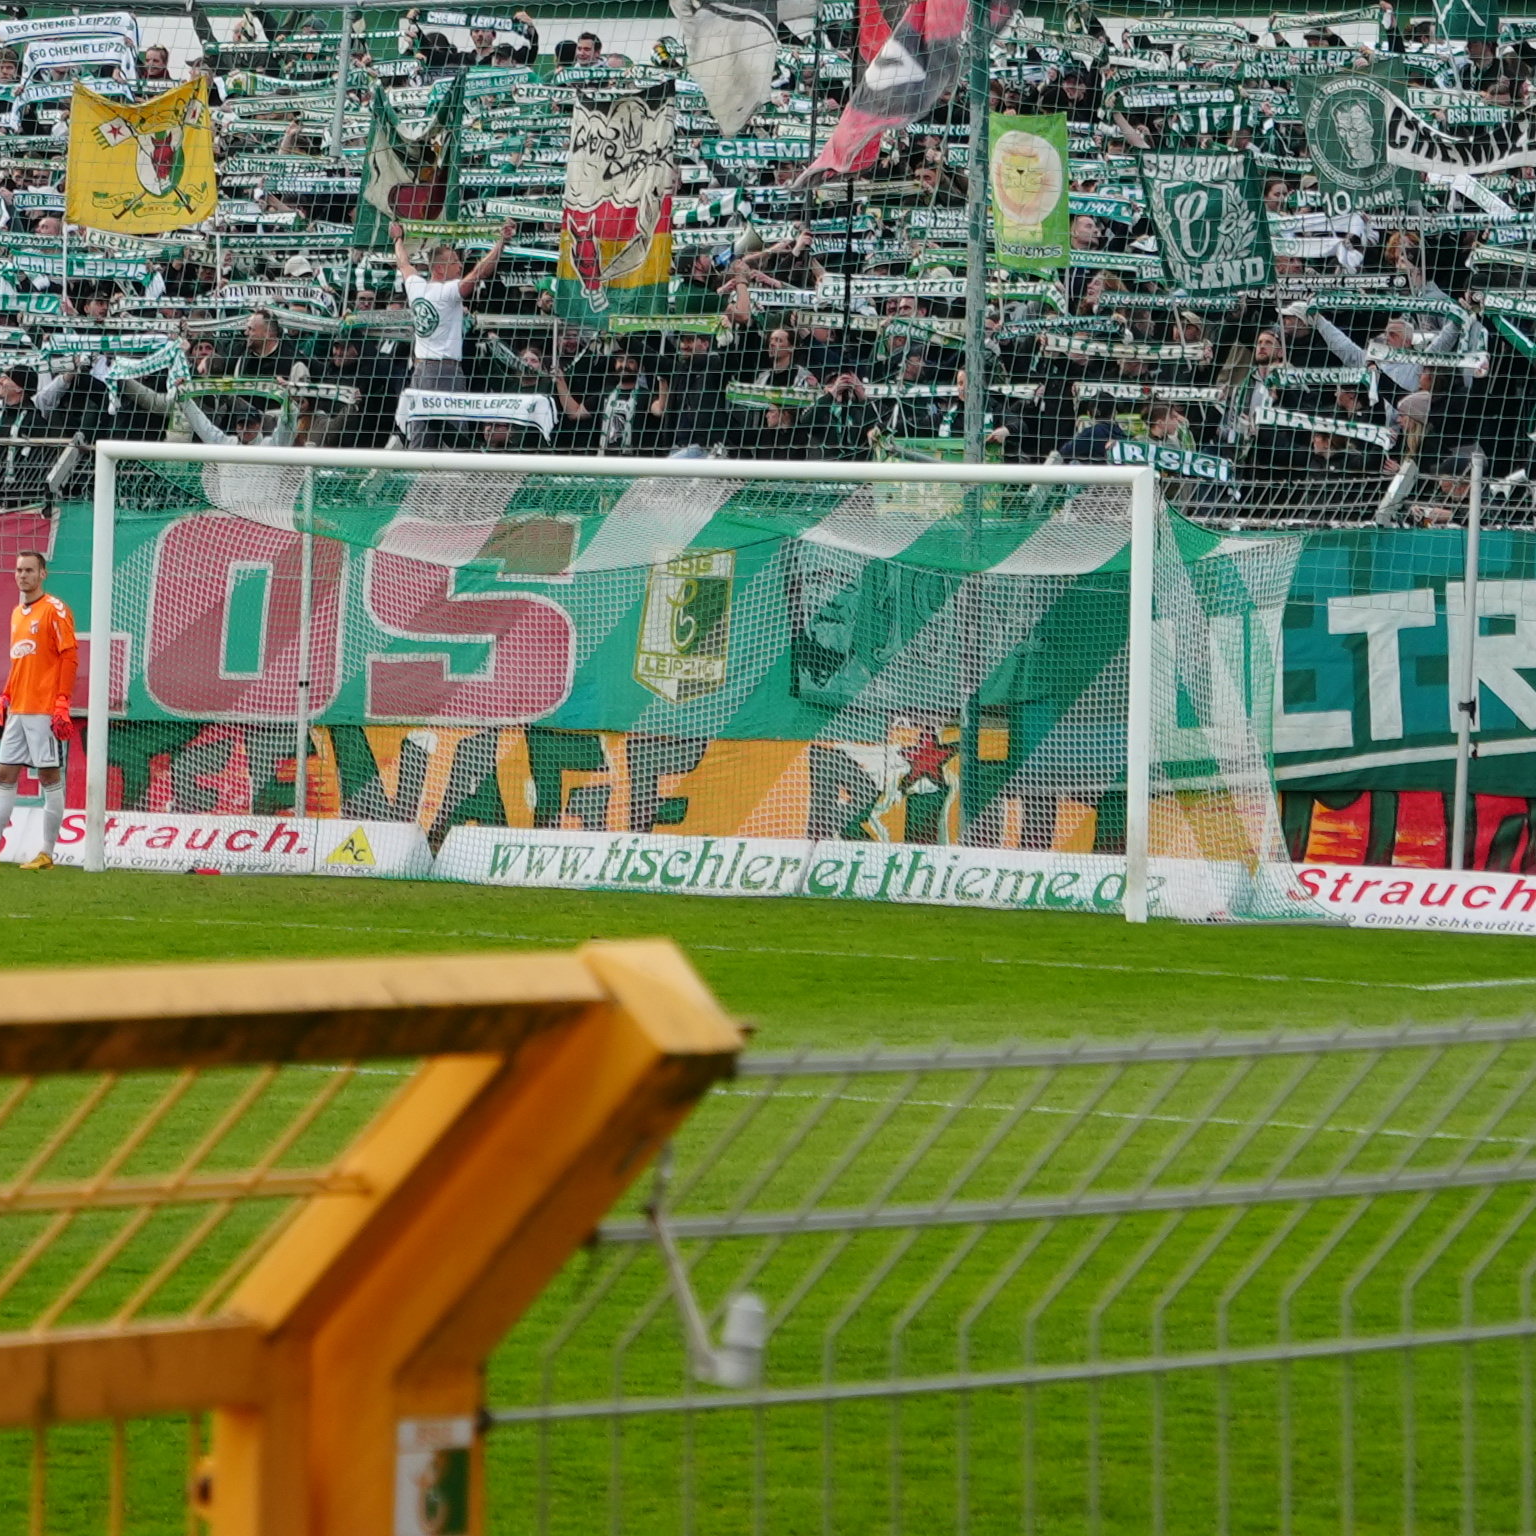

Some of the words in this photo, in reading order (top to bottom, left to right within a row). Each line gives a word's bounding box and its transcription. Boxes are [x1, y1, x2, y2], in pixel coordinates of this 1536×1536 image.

[1143, 153, 1246, 179] SEKTION
[1323, 193, 1352, 216] 10
[1364, 912, 1419, 928] GmbH
[1425, 916, 1535, 933] Schkeuditz
